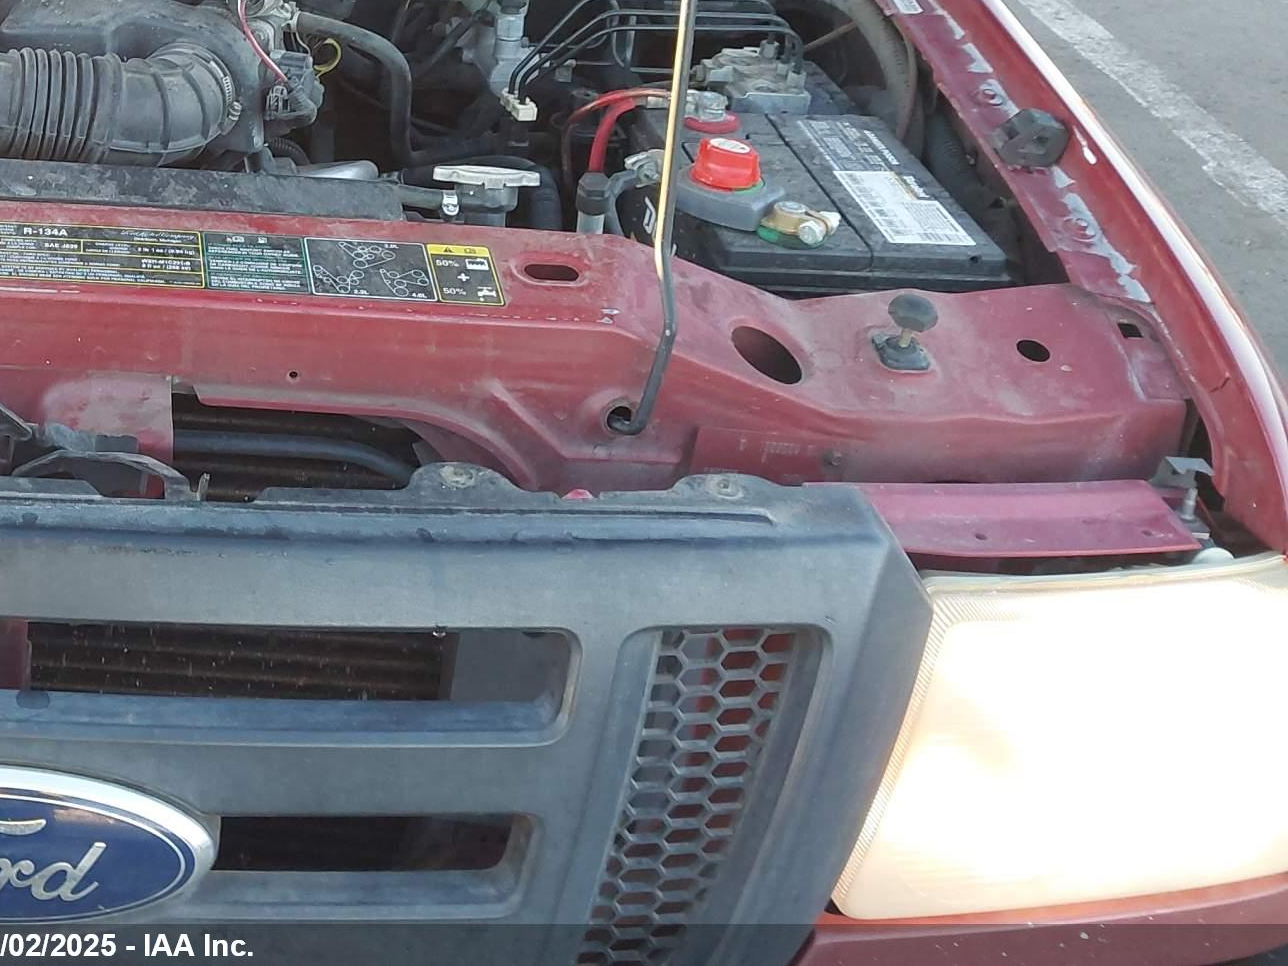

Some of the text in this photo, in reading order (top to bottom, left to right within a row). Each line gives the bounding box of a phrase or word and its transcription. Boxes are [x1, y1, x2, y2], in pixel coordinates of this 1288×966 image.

[23, 227, 69, 237] R-134A
[435, 259, 460, 267] 50%
[442, 288, 467, 296] 50%
